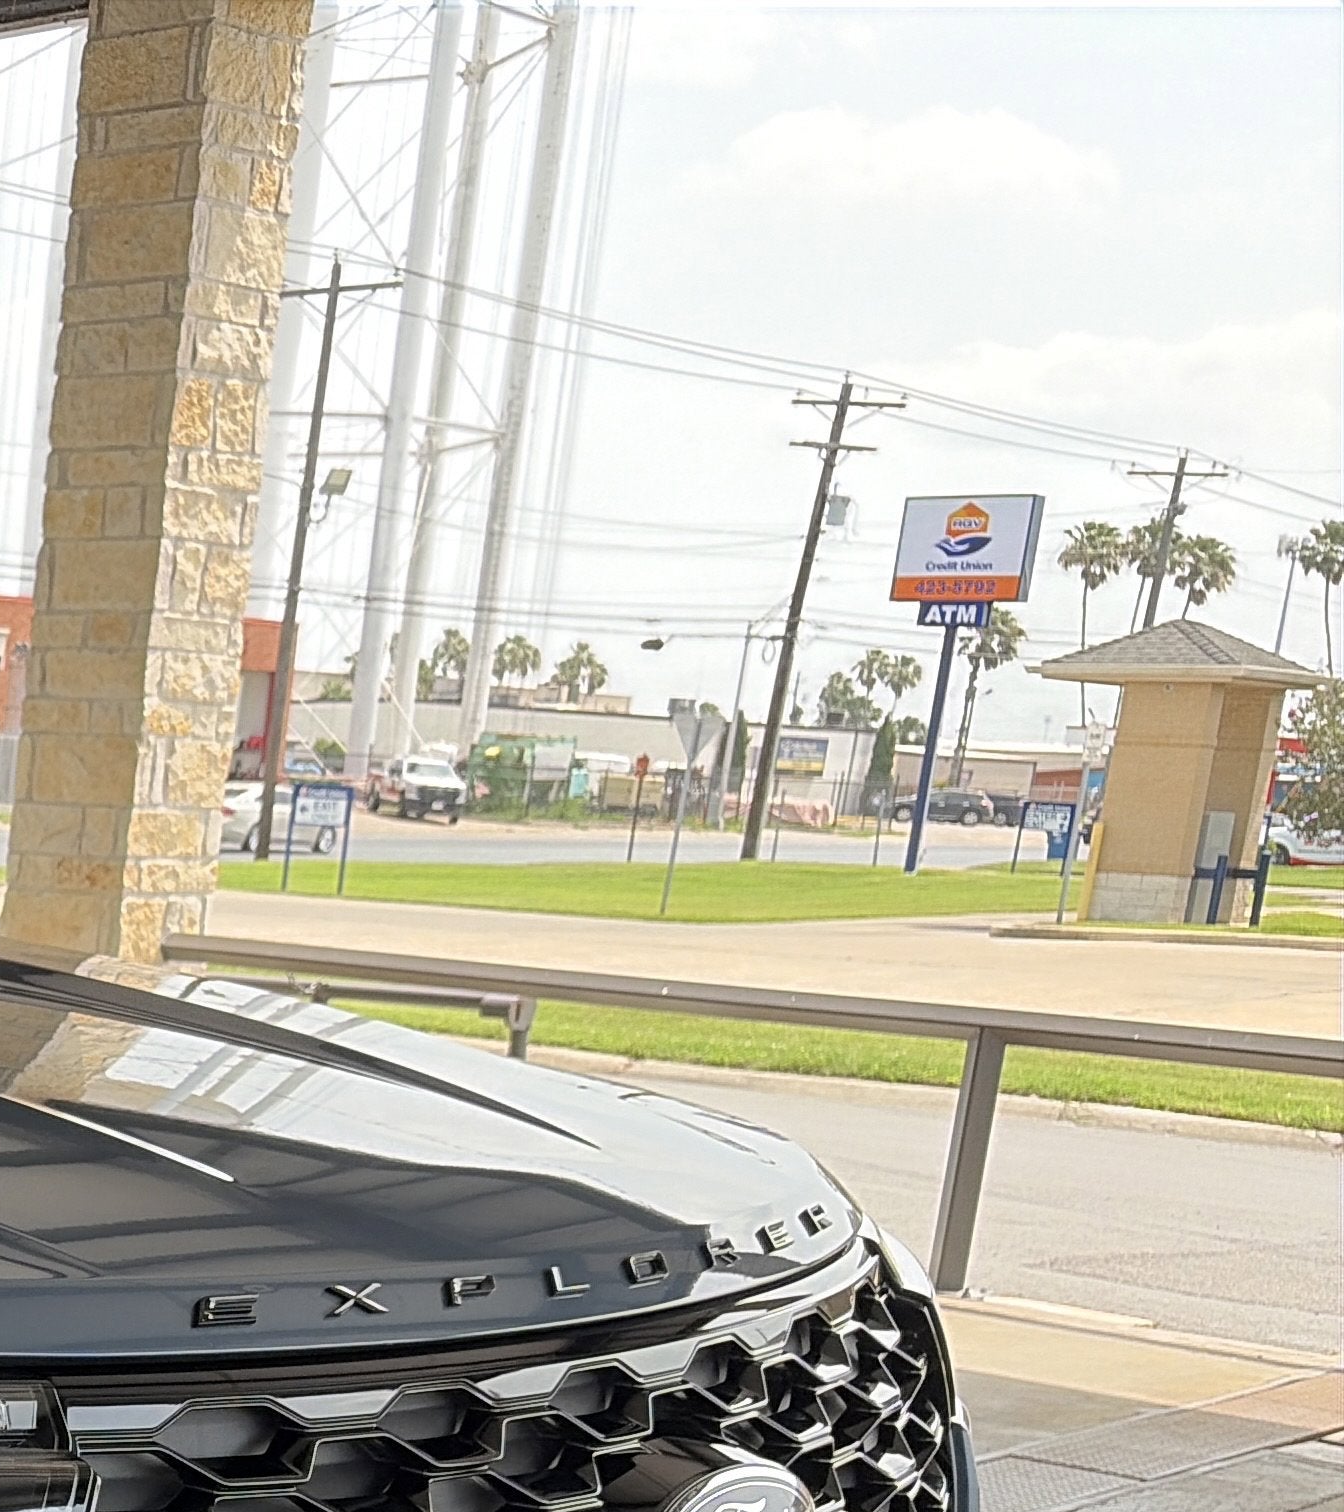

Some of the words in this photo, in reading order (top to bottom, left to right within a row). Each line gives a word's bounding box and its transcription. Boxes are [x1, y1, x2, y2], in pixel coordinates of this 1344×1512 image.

[925, 560, 958, 572] Credit
[960, 560, 993, 571] Union
[924, 604, 978, 624] ATM
[194, 1203, 833, 1327] EXPLORER
